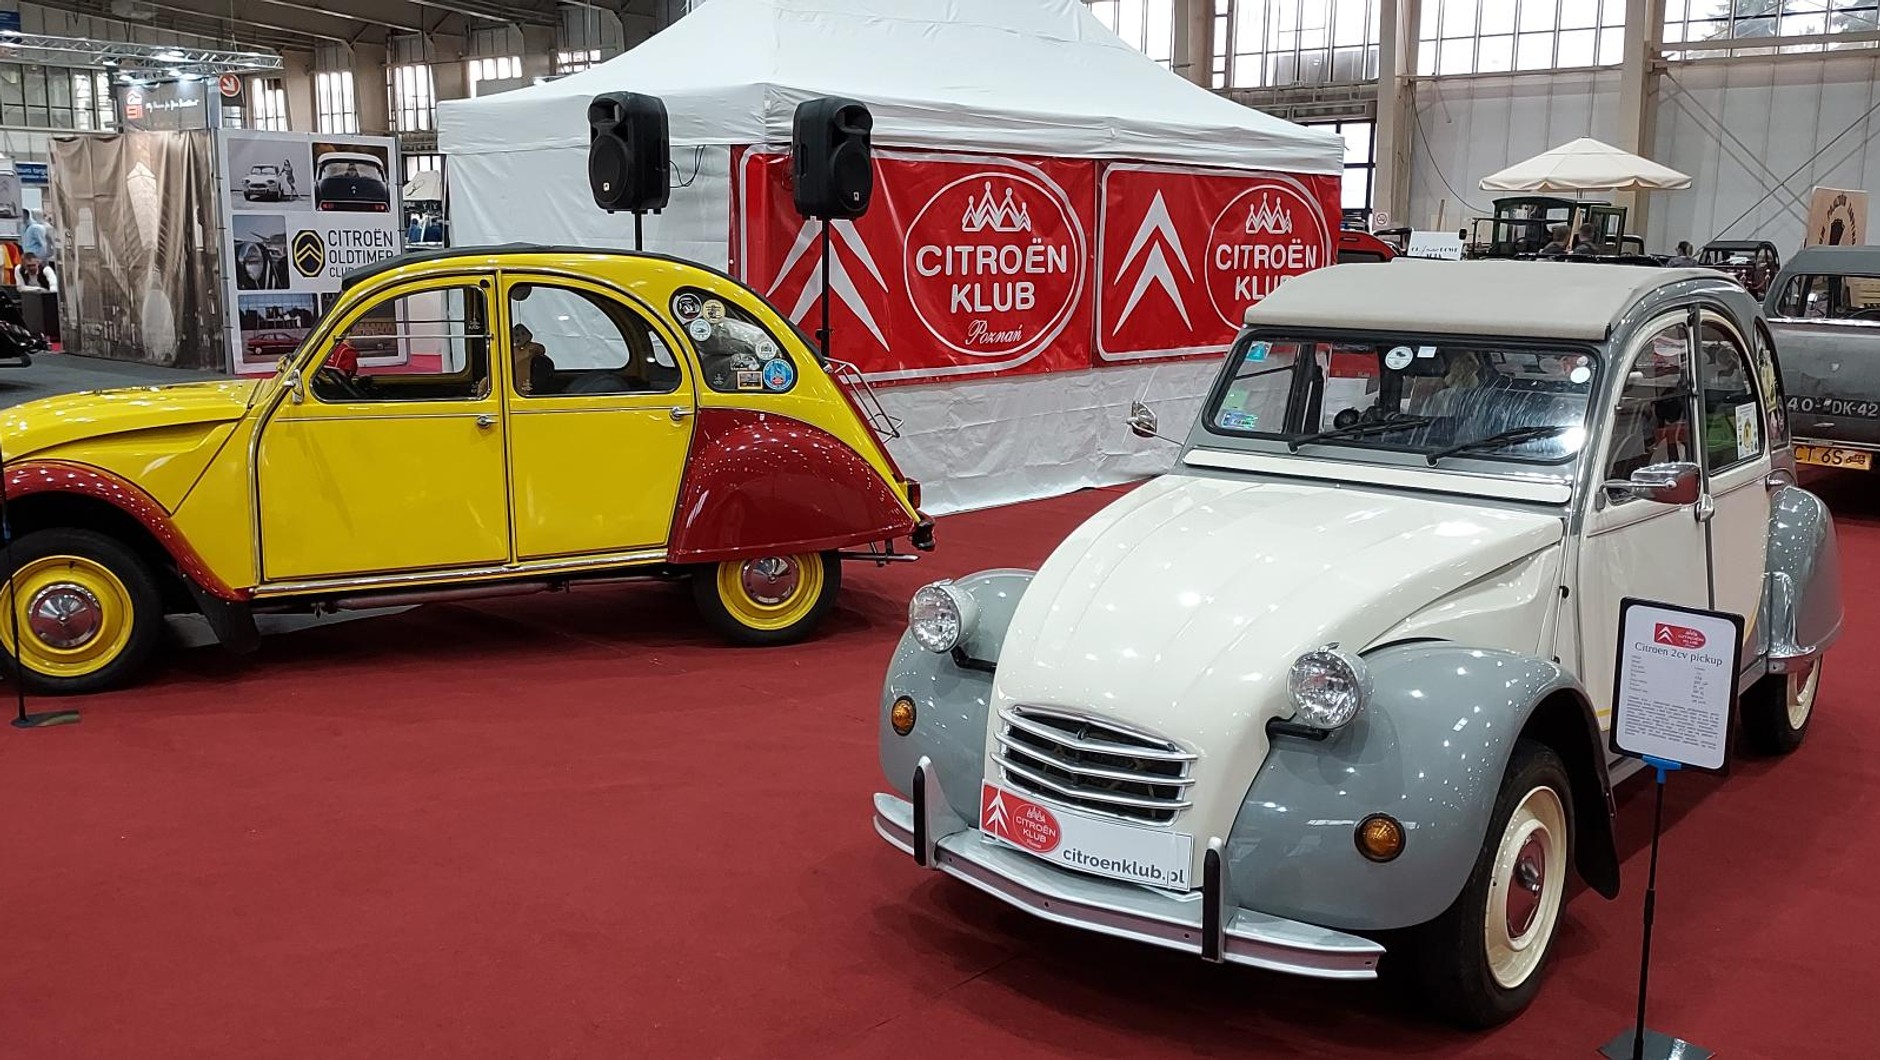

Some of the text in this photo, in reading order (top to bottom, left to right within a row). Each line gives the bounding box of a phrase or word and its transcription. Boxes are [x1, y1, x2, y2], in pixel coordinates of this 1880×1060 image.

[327, 228, 393, 247] CITROËN
[916, 238, 1067, 276] CITROËN
[1215, 238, 1317, 270] CITROËN
[950, 282, 1035, 314] KLUB
[965, 319, 1023, 345] Poznań
[1635, 641, 1669, 657] Citroen
[1671, 647, 1687, 660] 2cv
[1690, 651, 1723, 667] pickup
[1015, 816, 1056, 837] CITROËN
[1022, 828, 1047, 843] KLUB
[1063, 847, 1185, 884] citroenklub.pl
